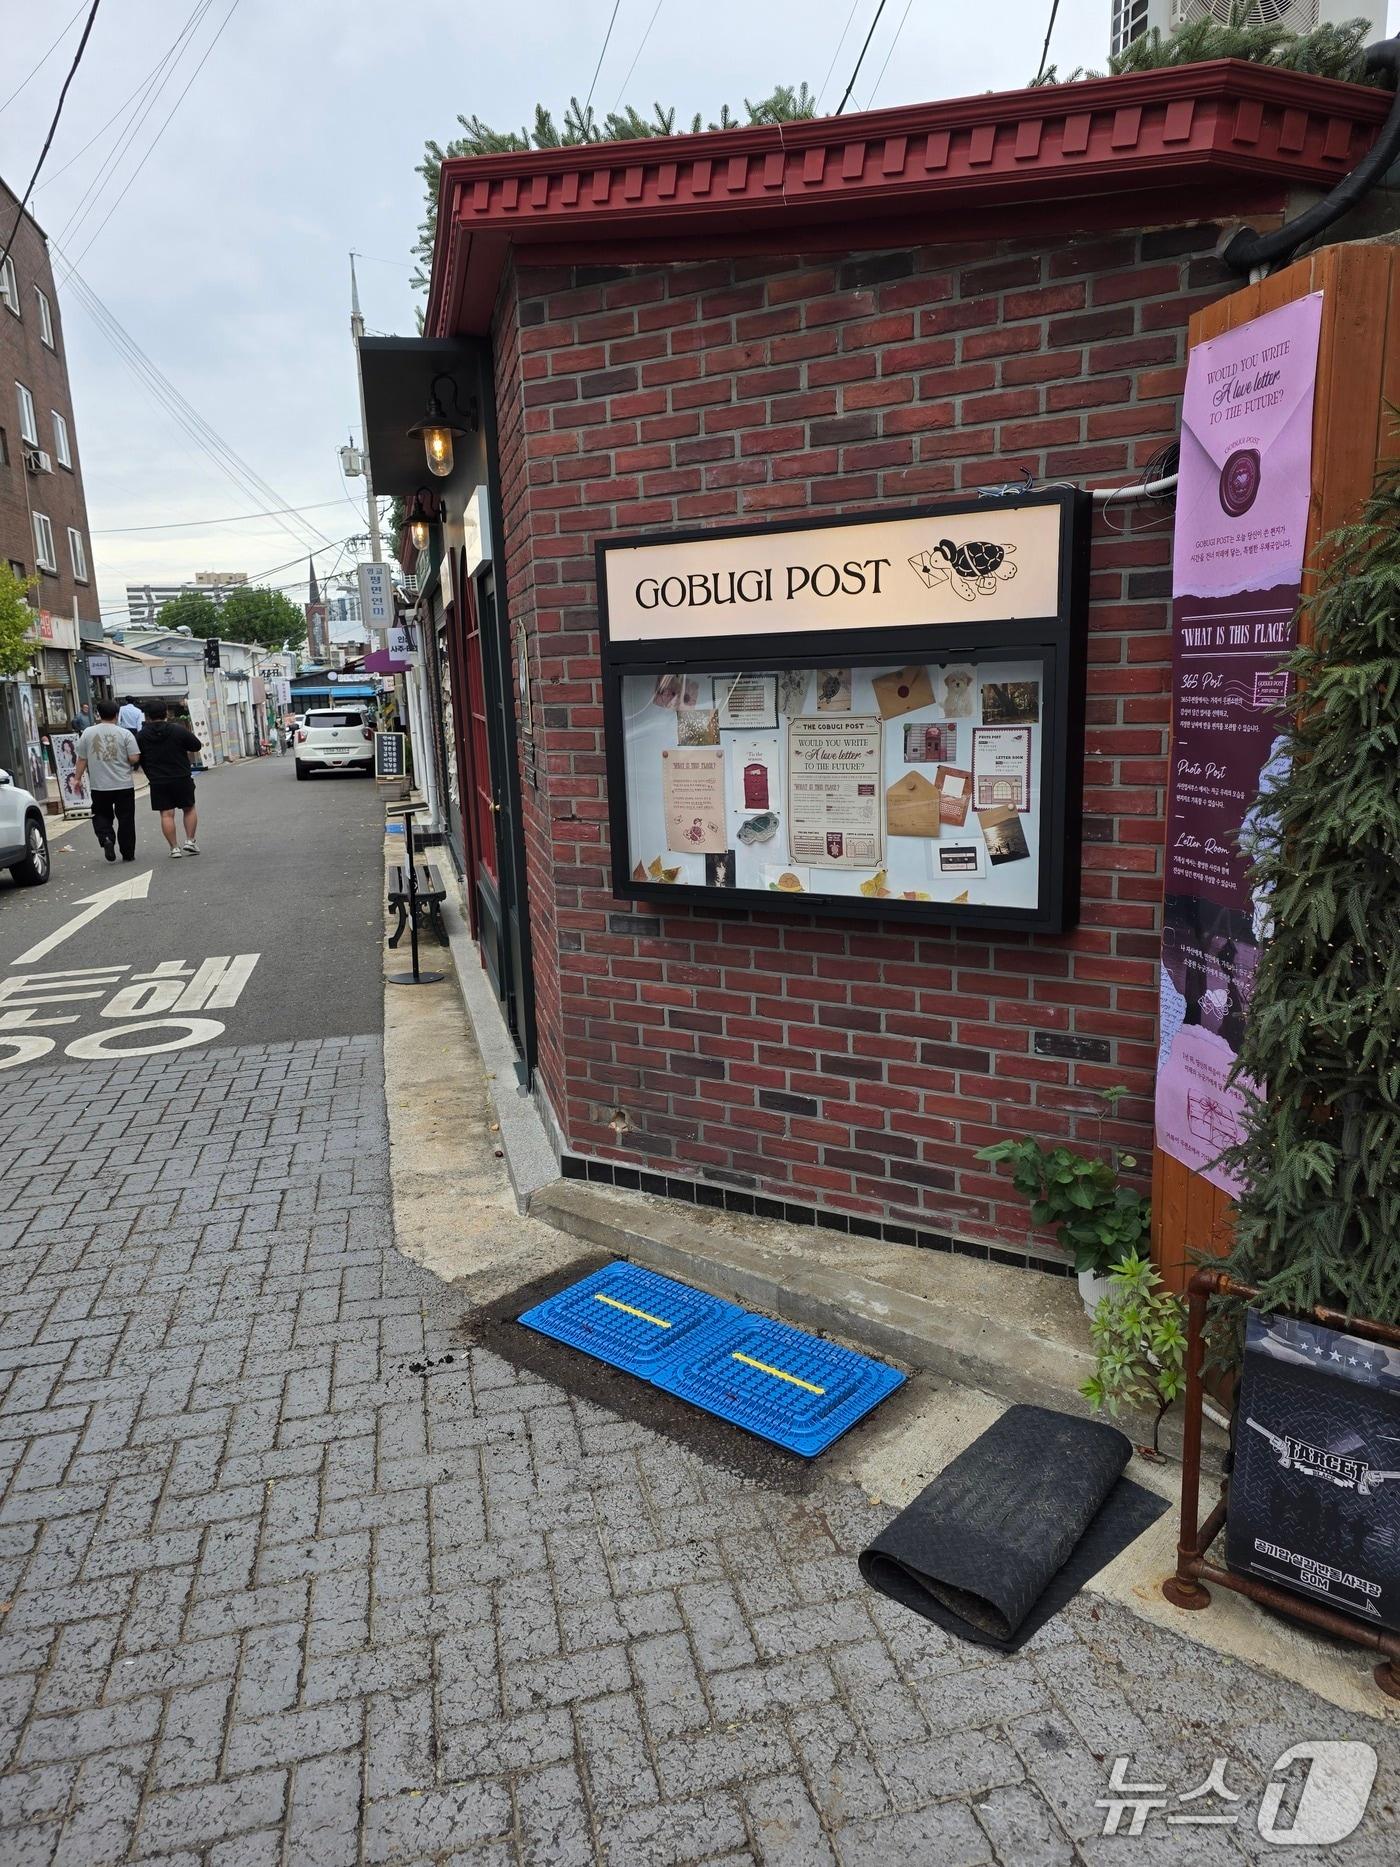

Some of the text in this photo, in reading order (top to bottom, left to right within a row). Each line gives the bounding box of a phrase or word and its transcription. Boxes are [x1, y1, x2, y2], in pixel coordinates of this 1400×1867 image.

[1208, 340, 1290, 384] WOULD YOU WRITE
[1213, 370, 1280, 407] A love letter
[1210, 389, 1283, 425] TO THE FUTURE?
[636, 559, 891, 609] GOBUGI POST
[1181, 622, 1291, 646] WHAT IS THIS PLACE?
[1181, 672, 1224, 690] 365 Post
[805, 747, 861, 760] A love letter
[1178, 759, 1226, 779] Photo Post
[1174, 832, 1230, 854] Letter Room
[1285, 1436, 1368, 1483] TARGET
[1291, 1554, 1316, 1572] 실감
[1342, 1574, 1382, 1597] 사격장
[1301, 1570, 1329, 1591] 50M
